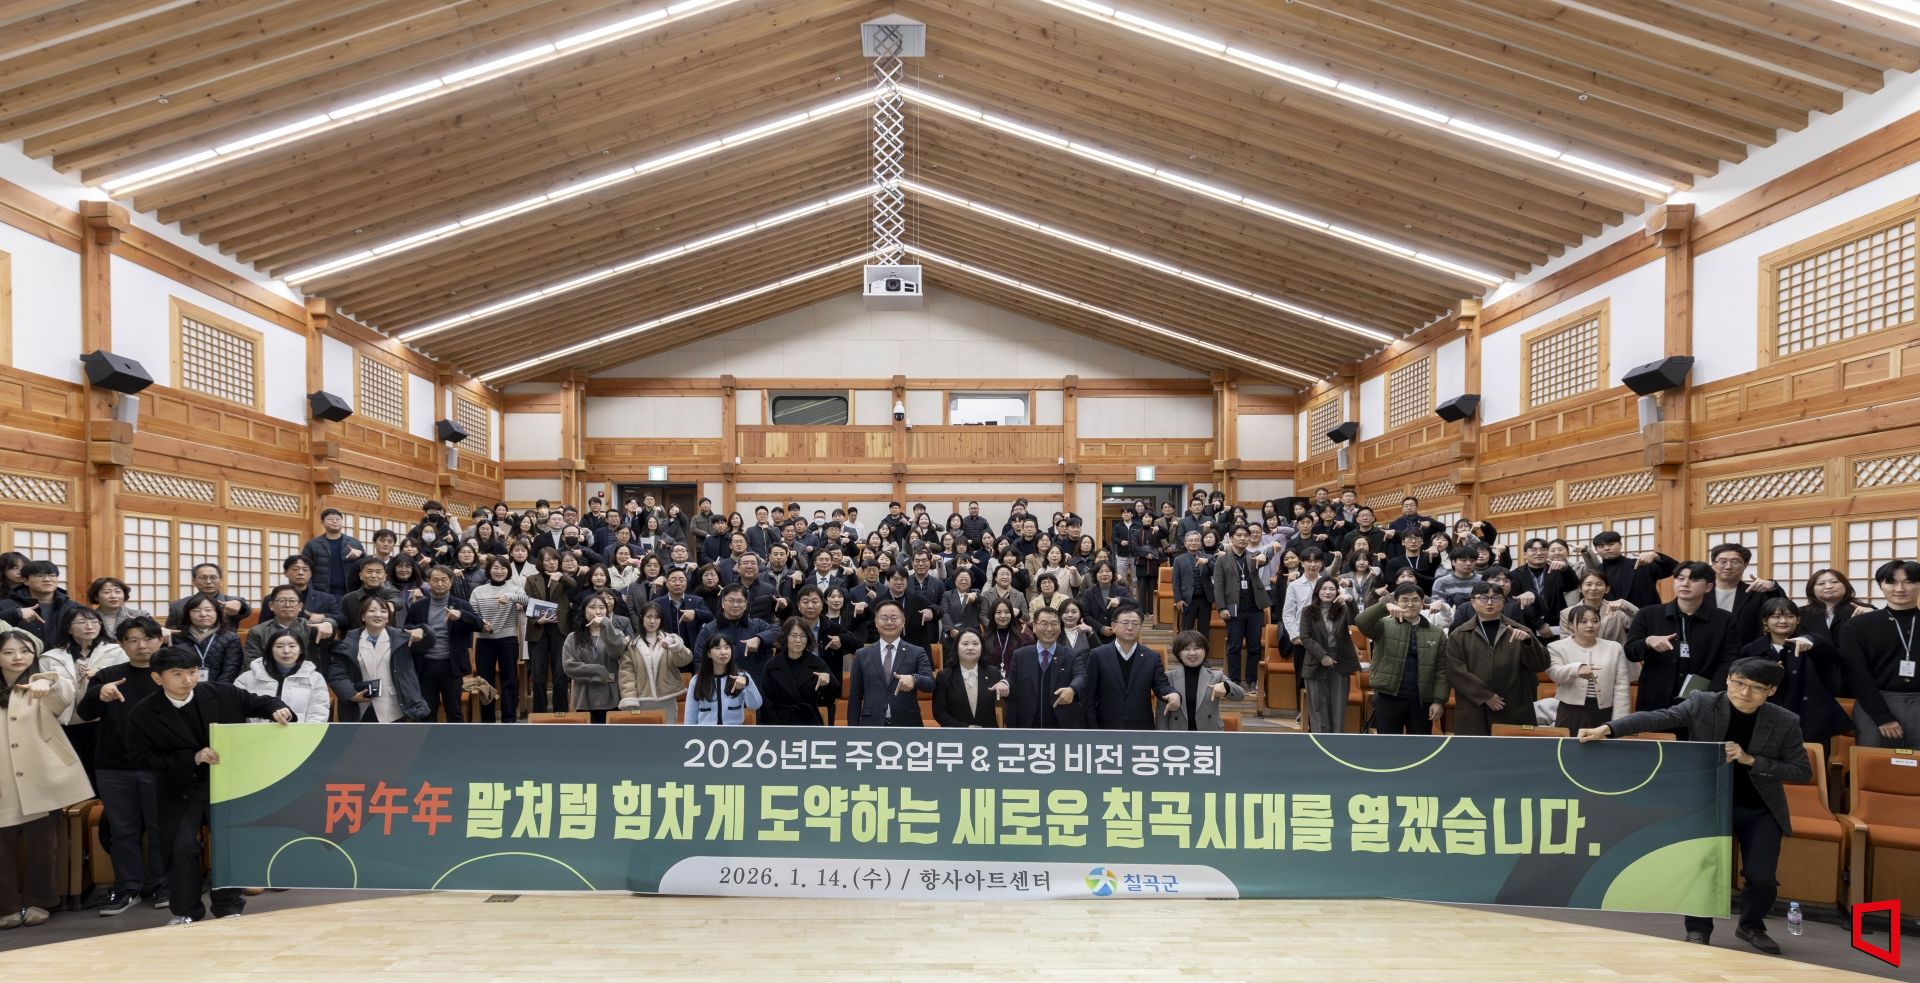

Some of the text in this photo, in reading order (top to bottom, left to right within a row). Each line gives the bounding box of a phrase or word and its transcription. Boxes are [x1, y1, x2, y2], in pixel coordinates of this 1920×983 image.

[683, 738, 1221, 777] 2026년도 주요업무 & 군정 비전 공유회
[325, 780, 1601, 857] 丙午年 말처럼 힘차게 도약하는 새로운 칠곡시대를 열겠습니다.
[719, 867, 779, 888] 2026.
[791, 868, 806, 888] 1.
[901, 868, 911, 890] /
[919, 868, 1051, 892] 향사아트센터
[1123, 873, 1180, 894] 칠곡군
